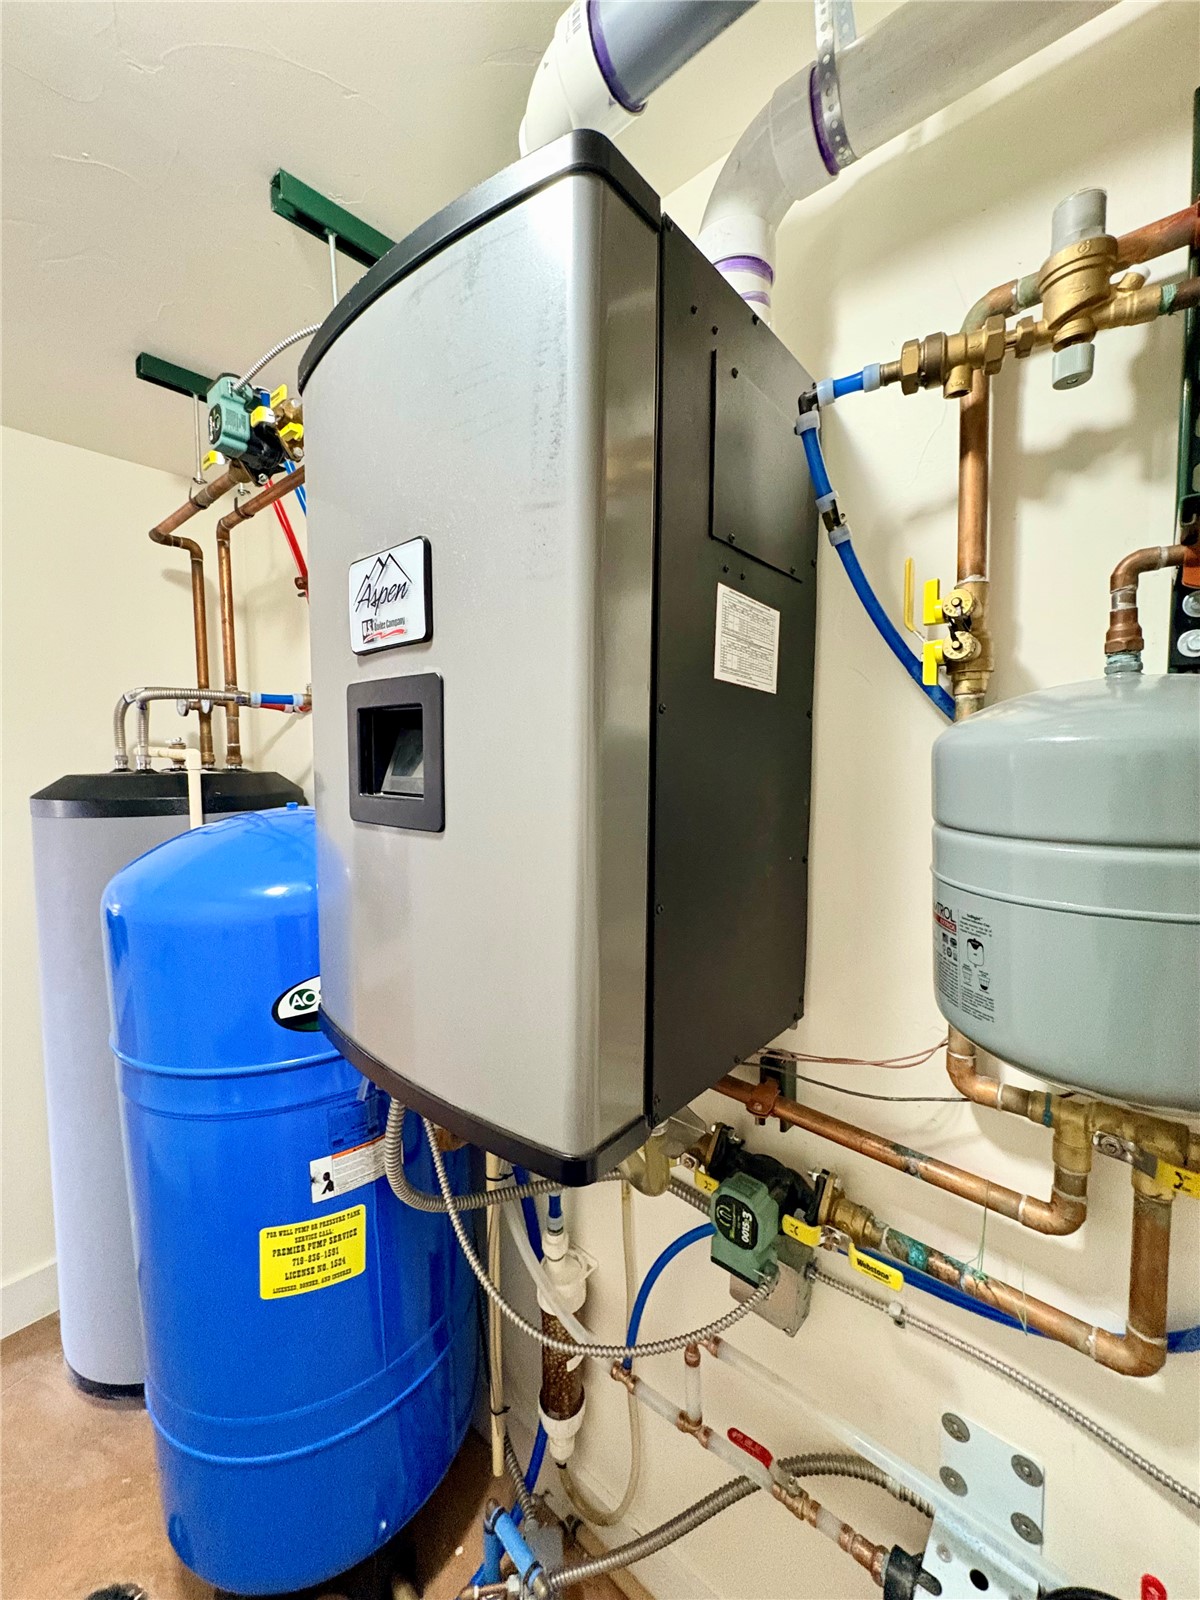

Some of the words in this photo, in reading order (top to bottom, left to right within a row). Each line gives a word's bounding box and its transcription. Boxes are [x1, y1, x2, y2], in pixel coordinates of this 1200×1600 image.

[355, 581, 408, 616] Aspen
[278, 1229, 294, 1237] WELL
[294, 1225, 310, 1235] PUMP
[319, 1214, 346, 1229] PRESSURE
[346, 1209, 361, 1220] TANK
[272, 1244, 306, 1258] PREMIER
[307, 1238, 328, 1252] PUMP
[328, 1227, 358, 1245] SERVICE
[294, 1232, 318, 1244] SERVICE
[284, 1266, 315, 1281] LICENSE
[316, 1263, 329, 1273] NO.
[856, 1257, 890, 1281] Webstone
